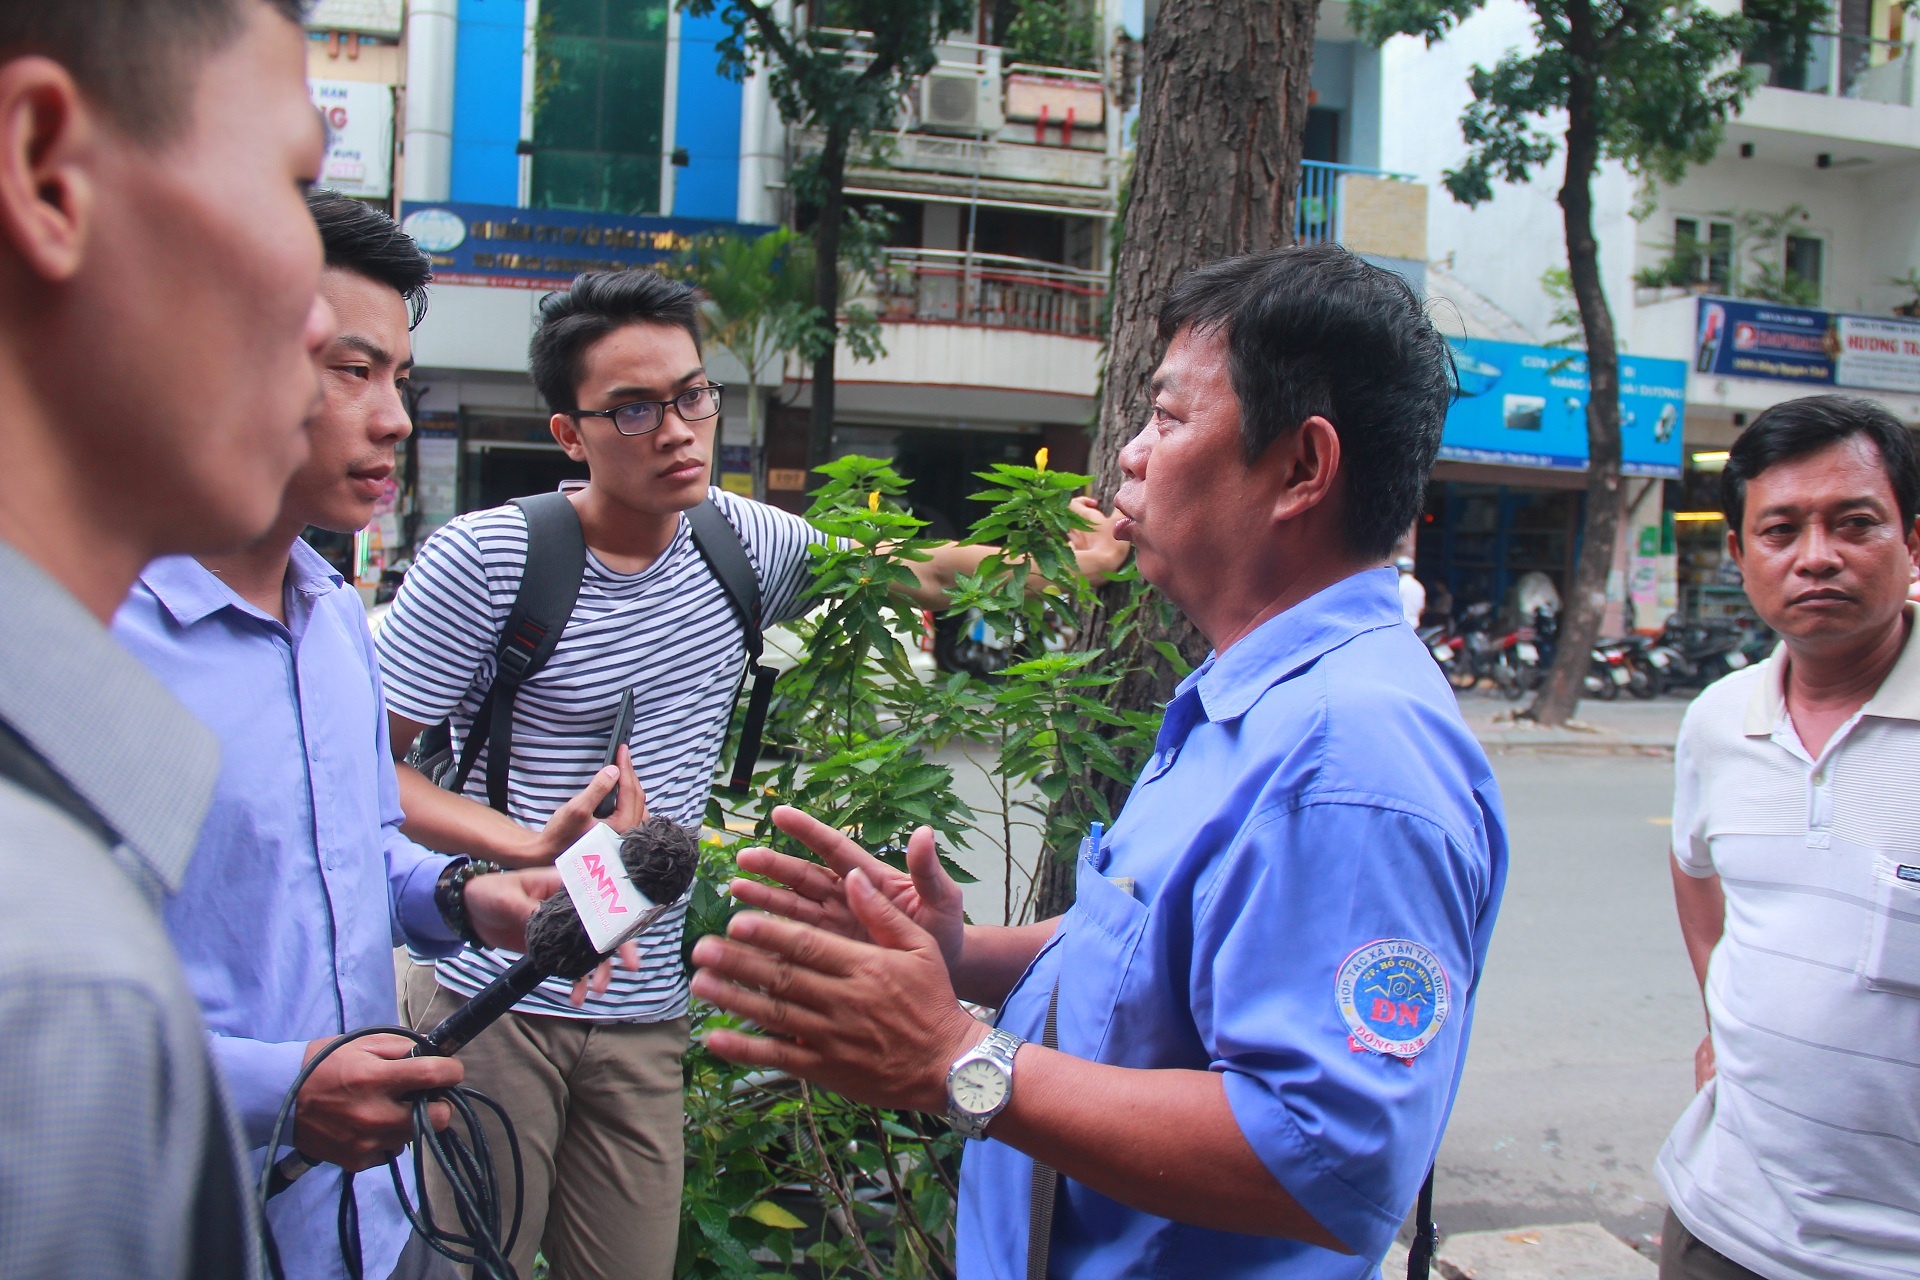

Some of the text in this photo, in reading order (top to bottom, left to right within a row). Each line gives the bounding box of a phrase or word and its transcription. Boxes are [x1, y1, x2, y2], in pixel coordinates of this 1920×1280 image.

[581, 854, 628, 914] ANTV
[1346, 957, 1368, 977] TÁC
[1368, 945, 1386, 960] XÃ
[1370, 997, 1421, 1028] ĐN
[1400, 1038, 1425, 1053] NAM
